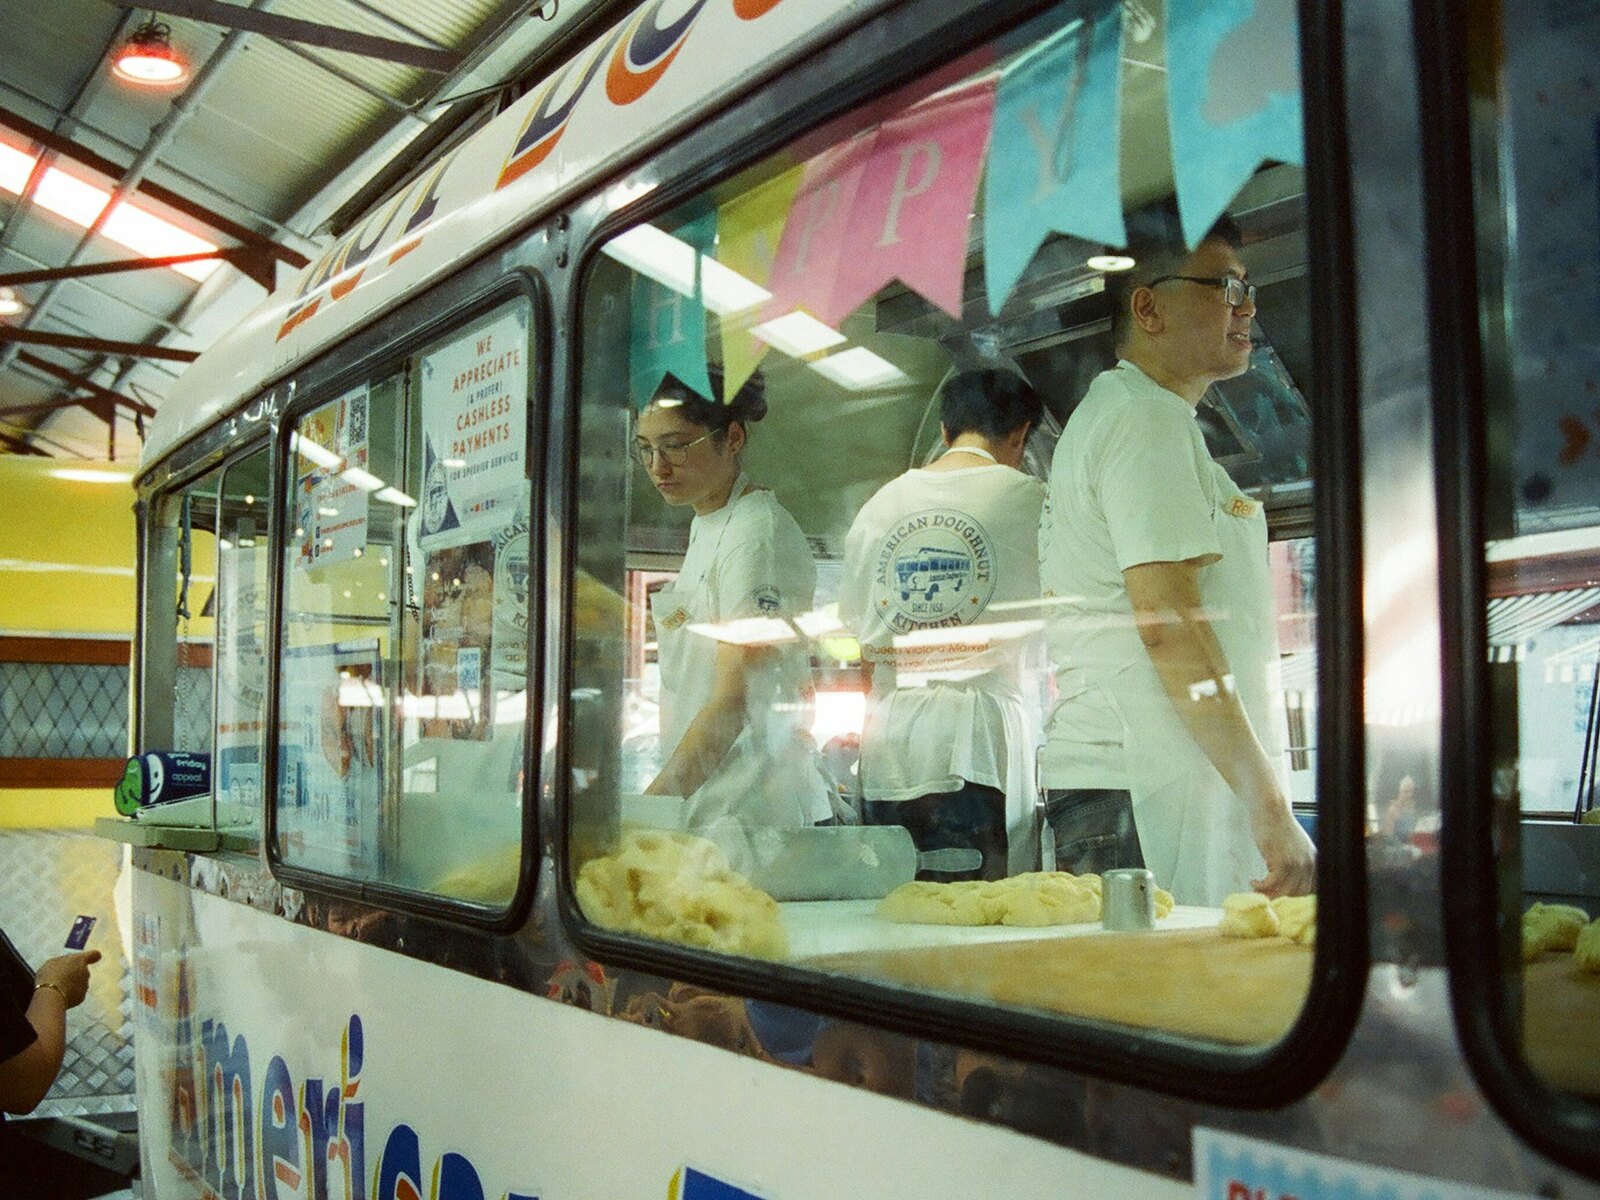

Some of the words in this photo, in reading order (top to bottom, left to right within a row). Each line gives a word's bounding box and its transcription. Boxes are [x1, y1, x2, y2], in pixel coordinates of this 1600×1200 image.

[476, 334, 492, 357] WE
[453, 349, 520, 393] APPRECIATE
[476, 381, 503, 401] PREFER)
[457, 394, 510, 431] CASHLESS
[453, 422, 509, 459] PAYMENTS
[491, 450, 518, 469] SERVICE
[877, 515, 928, 586] AMERICAN
[933, 514, 991, 583] DOUGHNUT
[893, 613, 962, 632] KITCHEN
[171, 773, 202, 783] appeal
